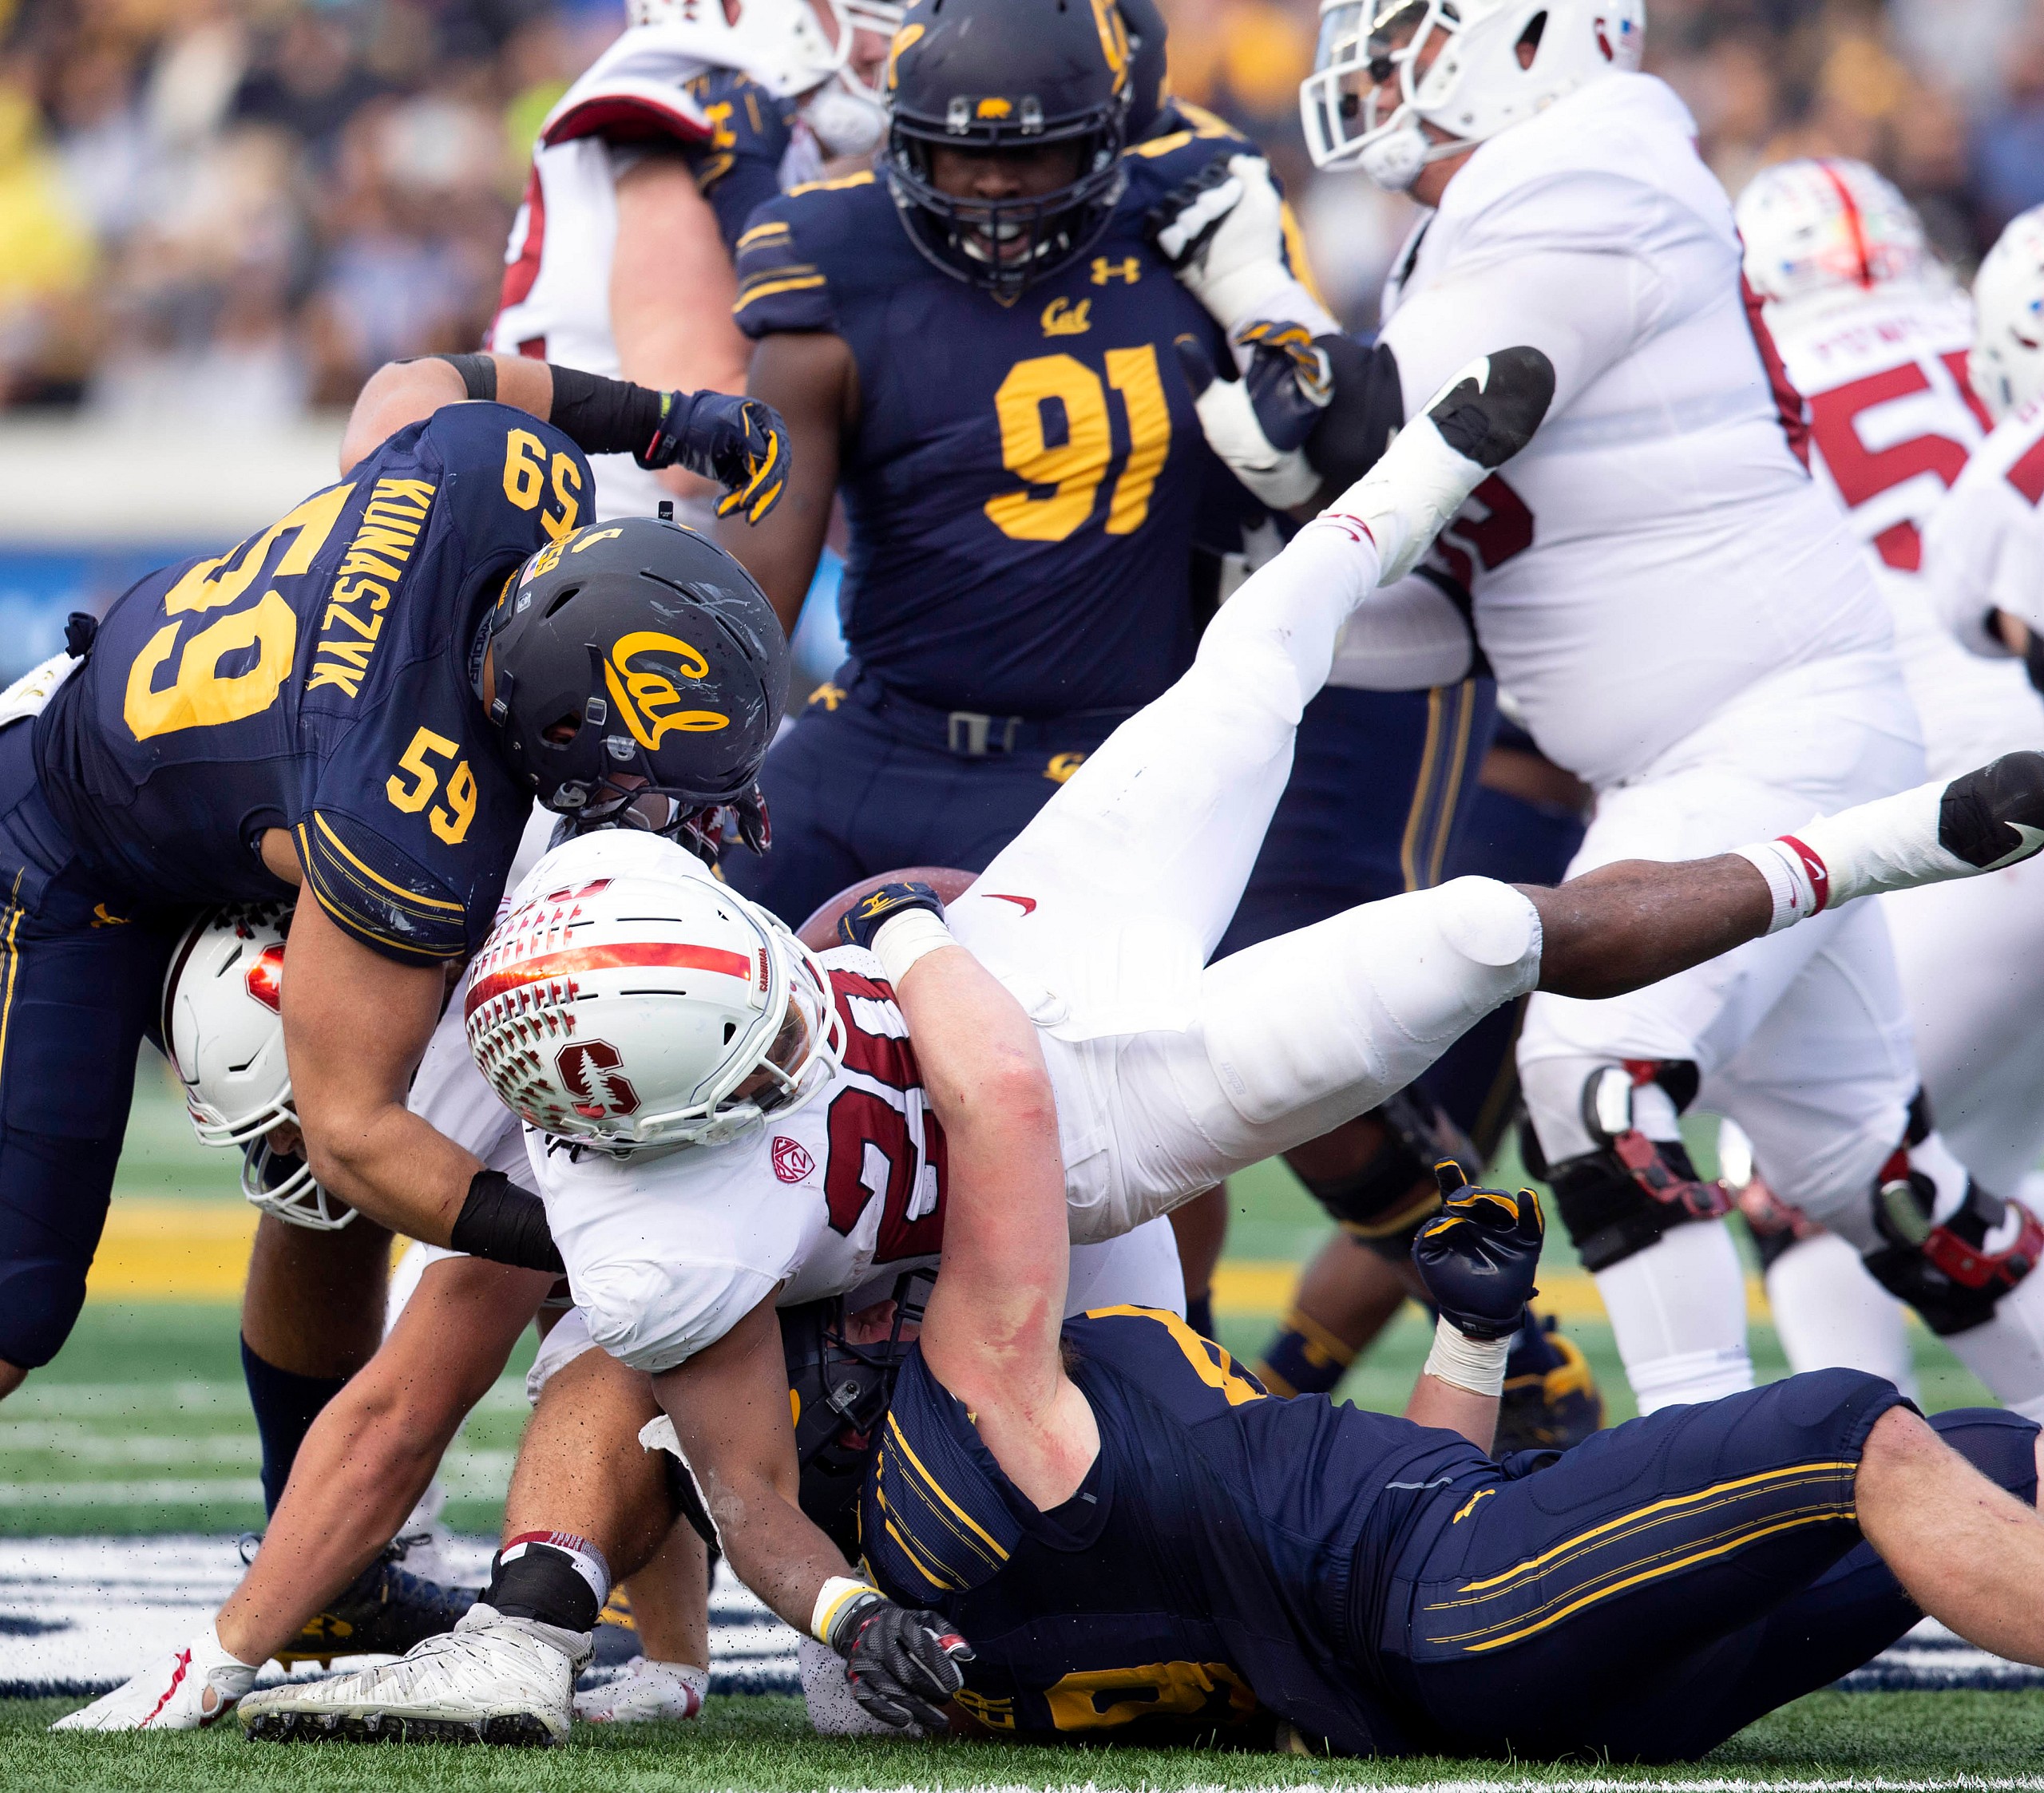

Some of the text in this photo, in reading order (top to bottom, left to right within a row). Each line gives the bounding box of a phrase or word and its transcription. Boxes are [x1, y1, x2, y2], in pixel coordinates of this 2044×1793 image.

[1040, 296, 1092, 338] Cal
[984, 342, 1172, 542] 91
[123, 481, 358, 742] 59
[307, 478, 437, 699] KUNASZYK
[604, 631, 731, 751] Cal
[386, 726, 477, 845] 59
